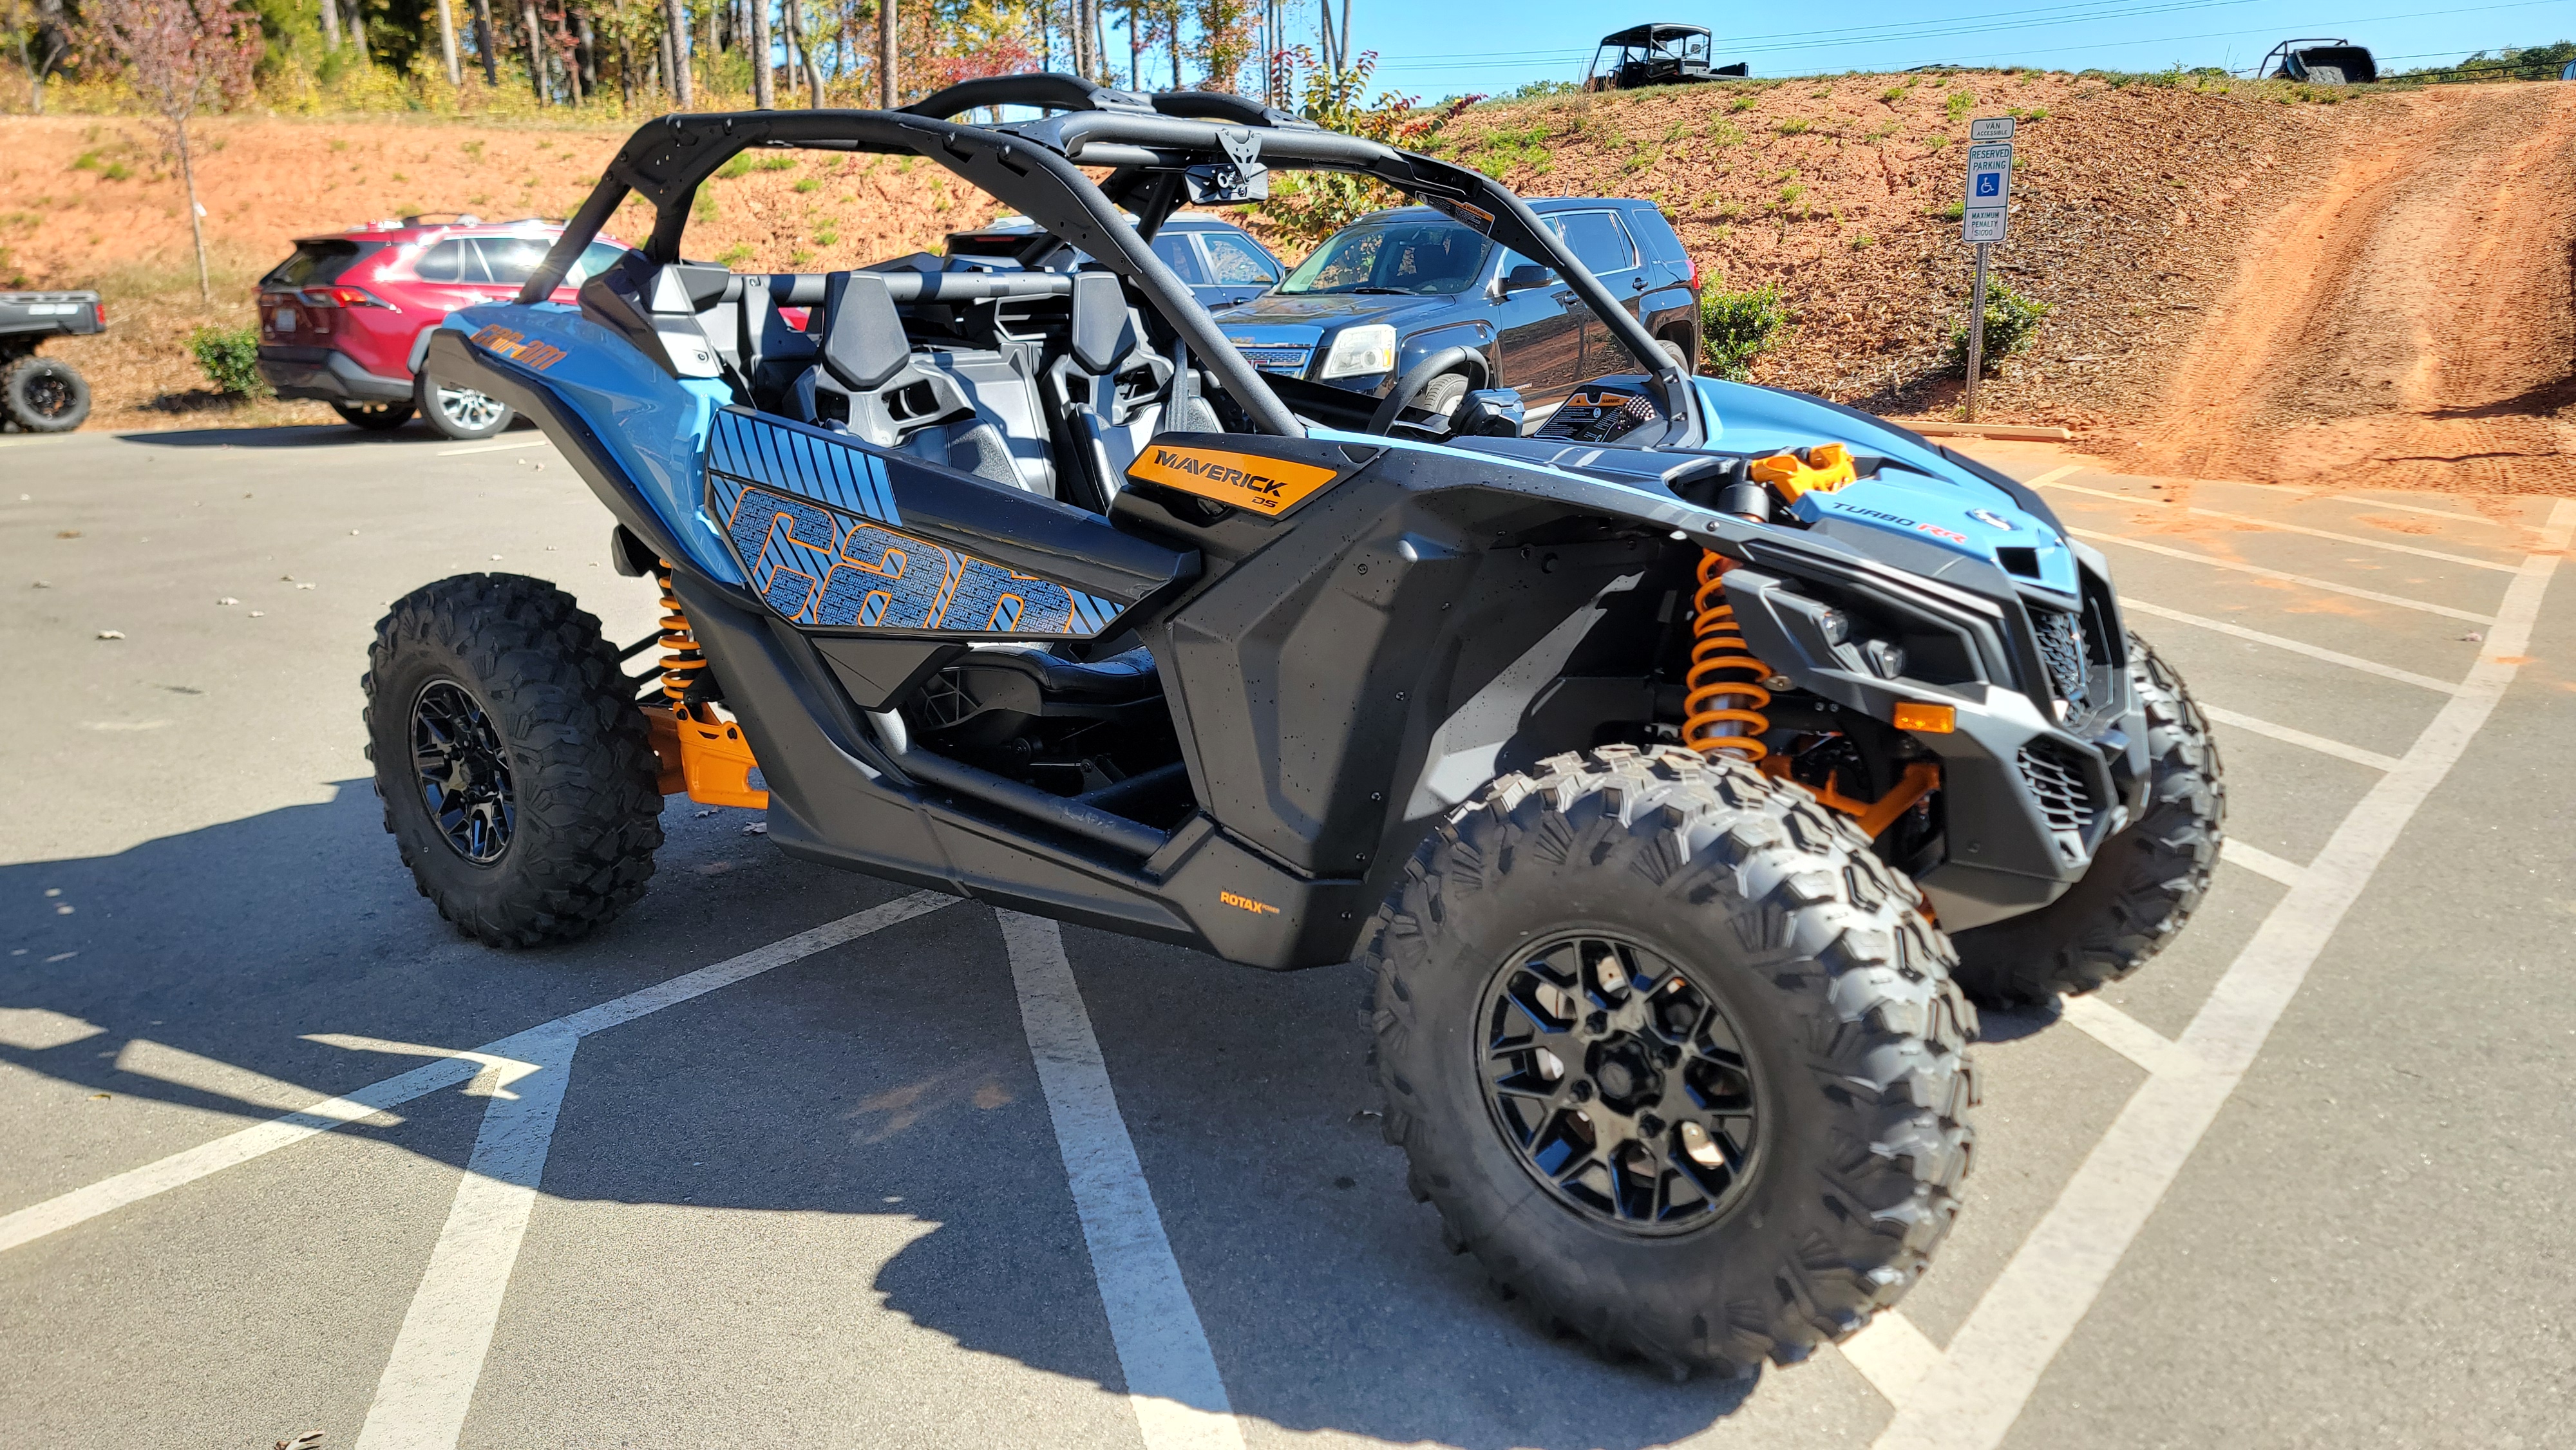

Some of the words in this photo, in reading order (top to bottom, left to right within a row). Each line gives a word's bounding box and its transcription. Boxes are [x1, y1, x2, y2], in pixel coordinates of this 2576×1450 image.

[1971, 149, 2009, 160] RESERVED
[1973, 160, 2006, 171] PARKING
[1154, 449, 1288, 498] MAVERICK
[1251, 496, 1278, 508] DS
[1832, 502, 1916, 526] TURBO
[1917, 523, 1968, 545] RR
[1220, 891, 1262, 914] ROTAX
